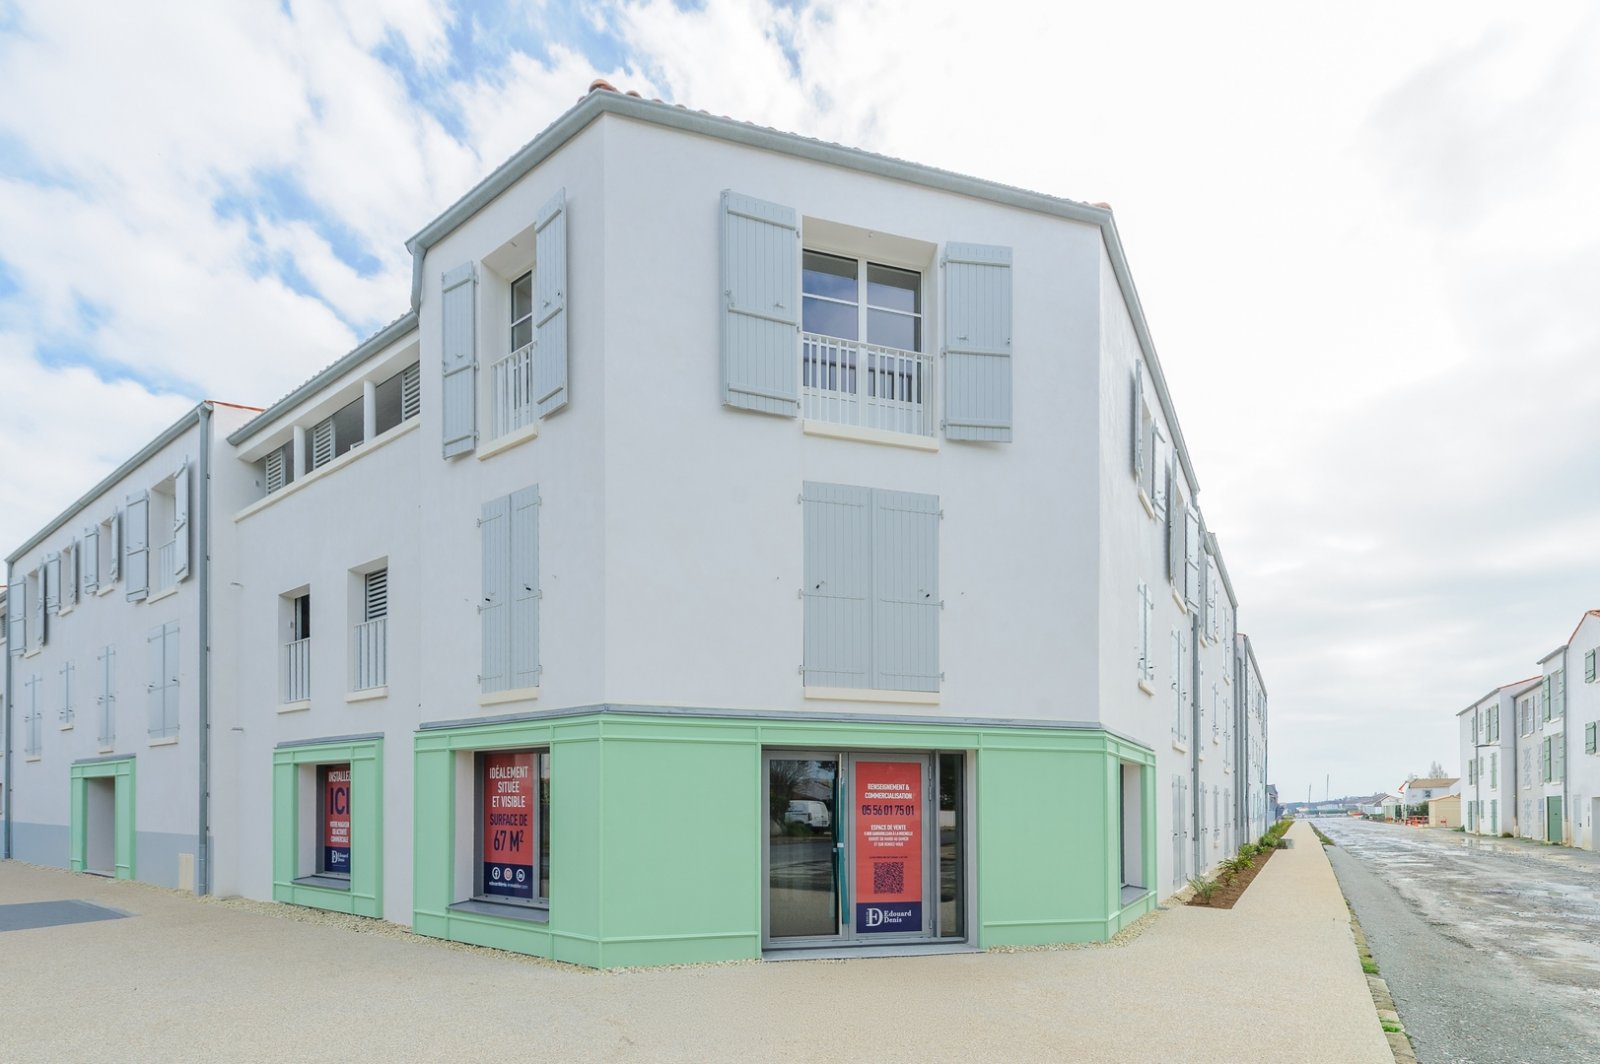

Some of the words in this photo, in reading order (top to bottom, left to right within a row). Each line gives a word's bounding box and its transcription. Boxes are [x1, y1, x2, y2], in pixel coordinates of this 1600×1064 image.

[490, 765, 528, 779] IDÉALEMENT
[497, 779, 520, 793] SITUÉE
[330, 787, 350, 815] ICI
[492, 796, 500, 808] ET
[501, 796, 526, 808] VISIBLE
[862, 804, 872, 816] 05
[872, 804, 883, 816] 56
[884, 804, 893, 816] 01
[894, 804, 904, 816] 75
[906, 804, 914, 816] 01
[490, 814, 518, 826] SURFACE
[519, 814, 528, 826] DE
[494, 830, 507, 851] 67
